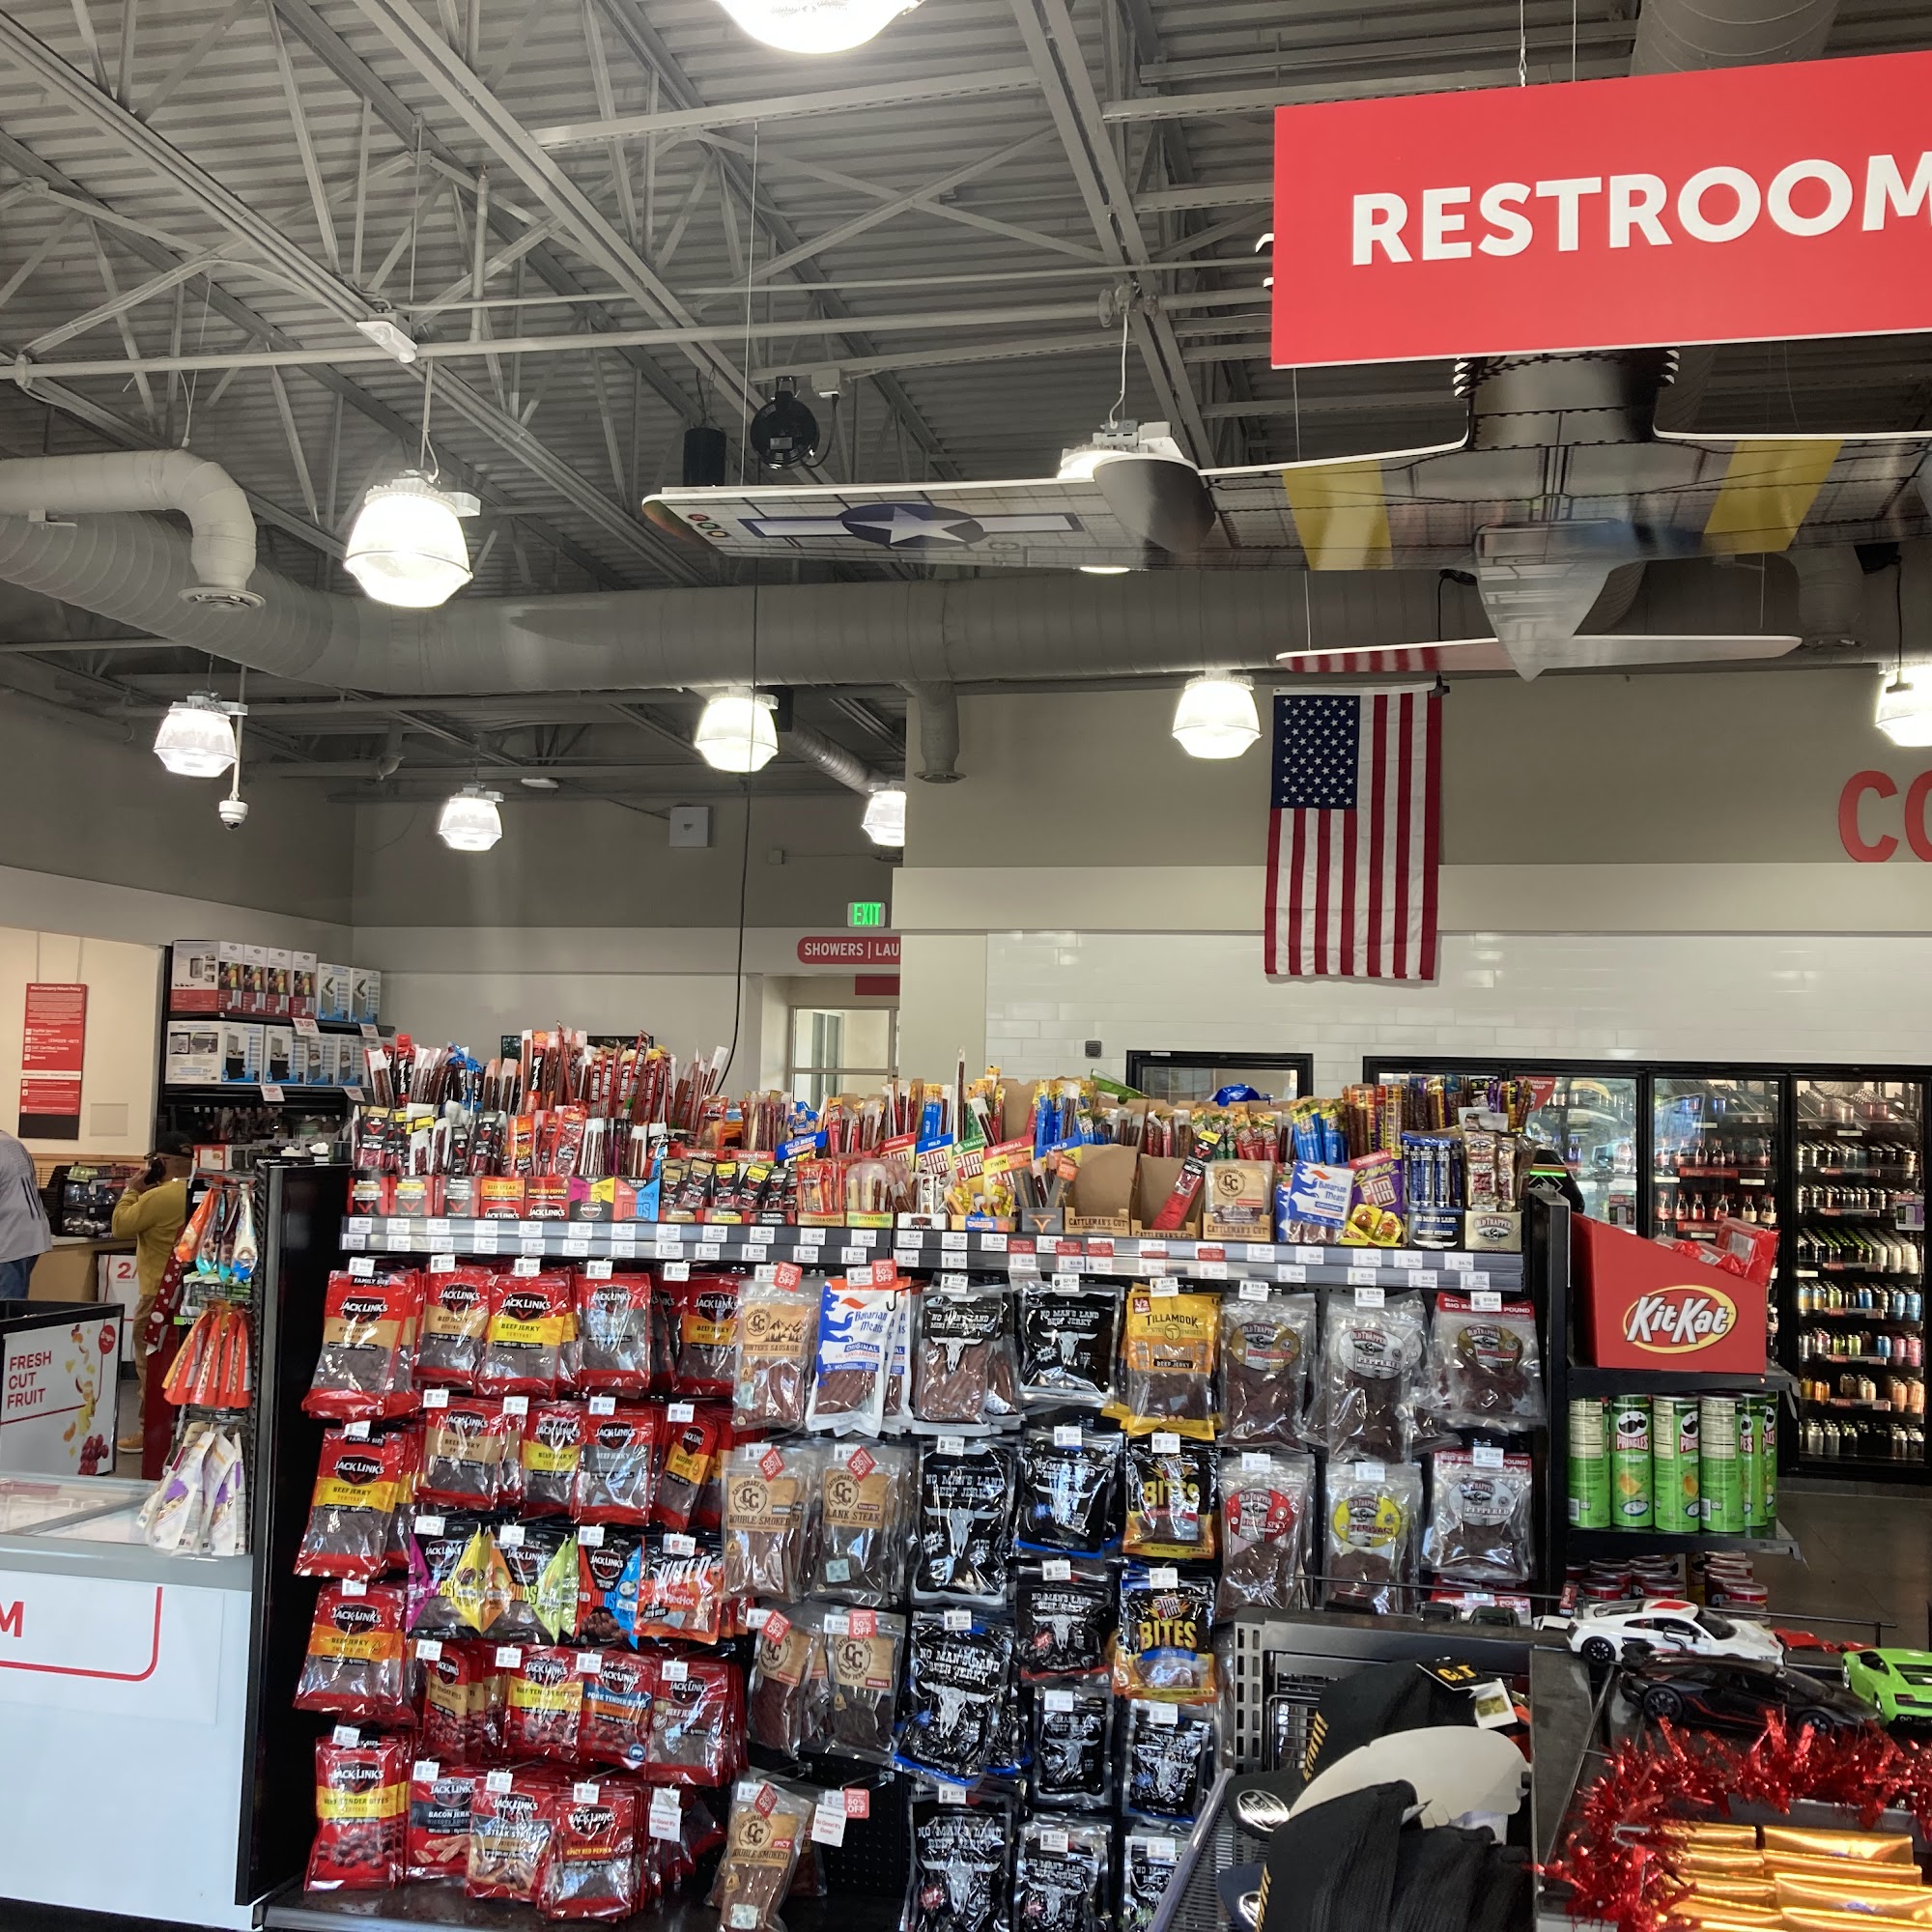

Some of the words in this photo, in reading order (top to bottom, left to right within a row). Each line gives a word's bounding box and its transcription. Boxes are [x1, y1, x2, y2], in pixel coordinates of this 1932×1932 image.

[1352, 151, 1932, 266] RESTROOM
[853, 903, 881, 925] EXIT
[805, 943, 864, 956] SHOWERS
[800, 1135, 817, 1145] BEEF
[927, 1139, 941, 1148] MILD
[991, 1142, 1023, 1154] ORIGINAL
[1356, 1152, 1390, 1166] ORIGINAL
[528, 1208, 544, 1217] JACK
[1113, 1218, 1127, 1227] CUT
[1254, 1225, 1268, 1235] CUT
[778, 1276, 796, 1287] OFF
[340, 1302, 362, 1312] JACK
[500, 1297, 524, 1309] JACK
[855, 1310, 888, 1321] Bavarian
[1077, 1311, 1099, 1320] LAND
[1145, 1314, 1200, 1329] TILLAMOOK
[860, 1321, 883, 1333] Meats
[1066, 1318, 1092, 1327] JERKY
[9, 1350, 52, 1372] FRESH
[1156, 1359, 1171, 1368] BEEF
[1172, 1360, 1191, 1369] JERKY
[9, 1372, 37, 1390] CUT
[7, 1388, 46, 1409] FRUIT
[1617, 1435, 1649, 1450] PRINGLES
[333, 1460, 356, 1472] JACK
[926, 1474, 938, 1485] NO
[977, 1474, 1005, 1485] LAND
[852, 1510, 881, 1523] STEAK
[666, 1594, 695, 1606] RedHot
[853, 1626, 871, 1635] OFF
[1138, 1620, 1197, 1651] BITES
[920, 1648, 932, 1659] NO
[1437, 1664, 1477, 1682] CAT
[587, 1692, 604, 1701] PORK
[605, 1694, 625, 1705] TENDER
[431, 1784, 451, 1794] JACK
[567, 1847, 580, 1856] SPICY
